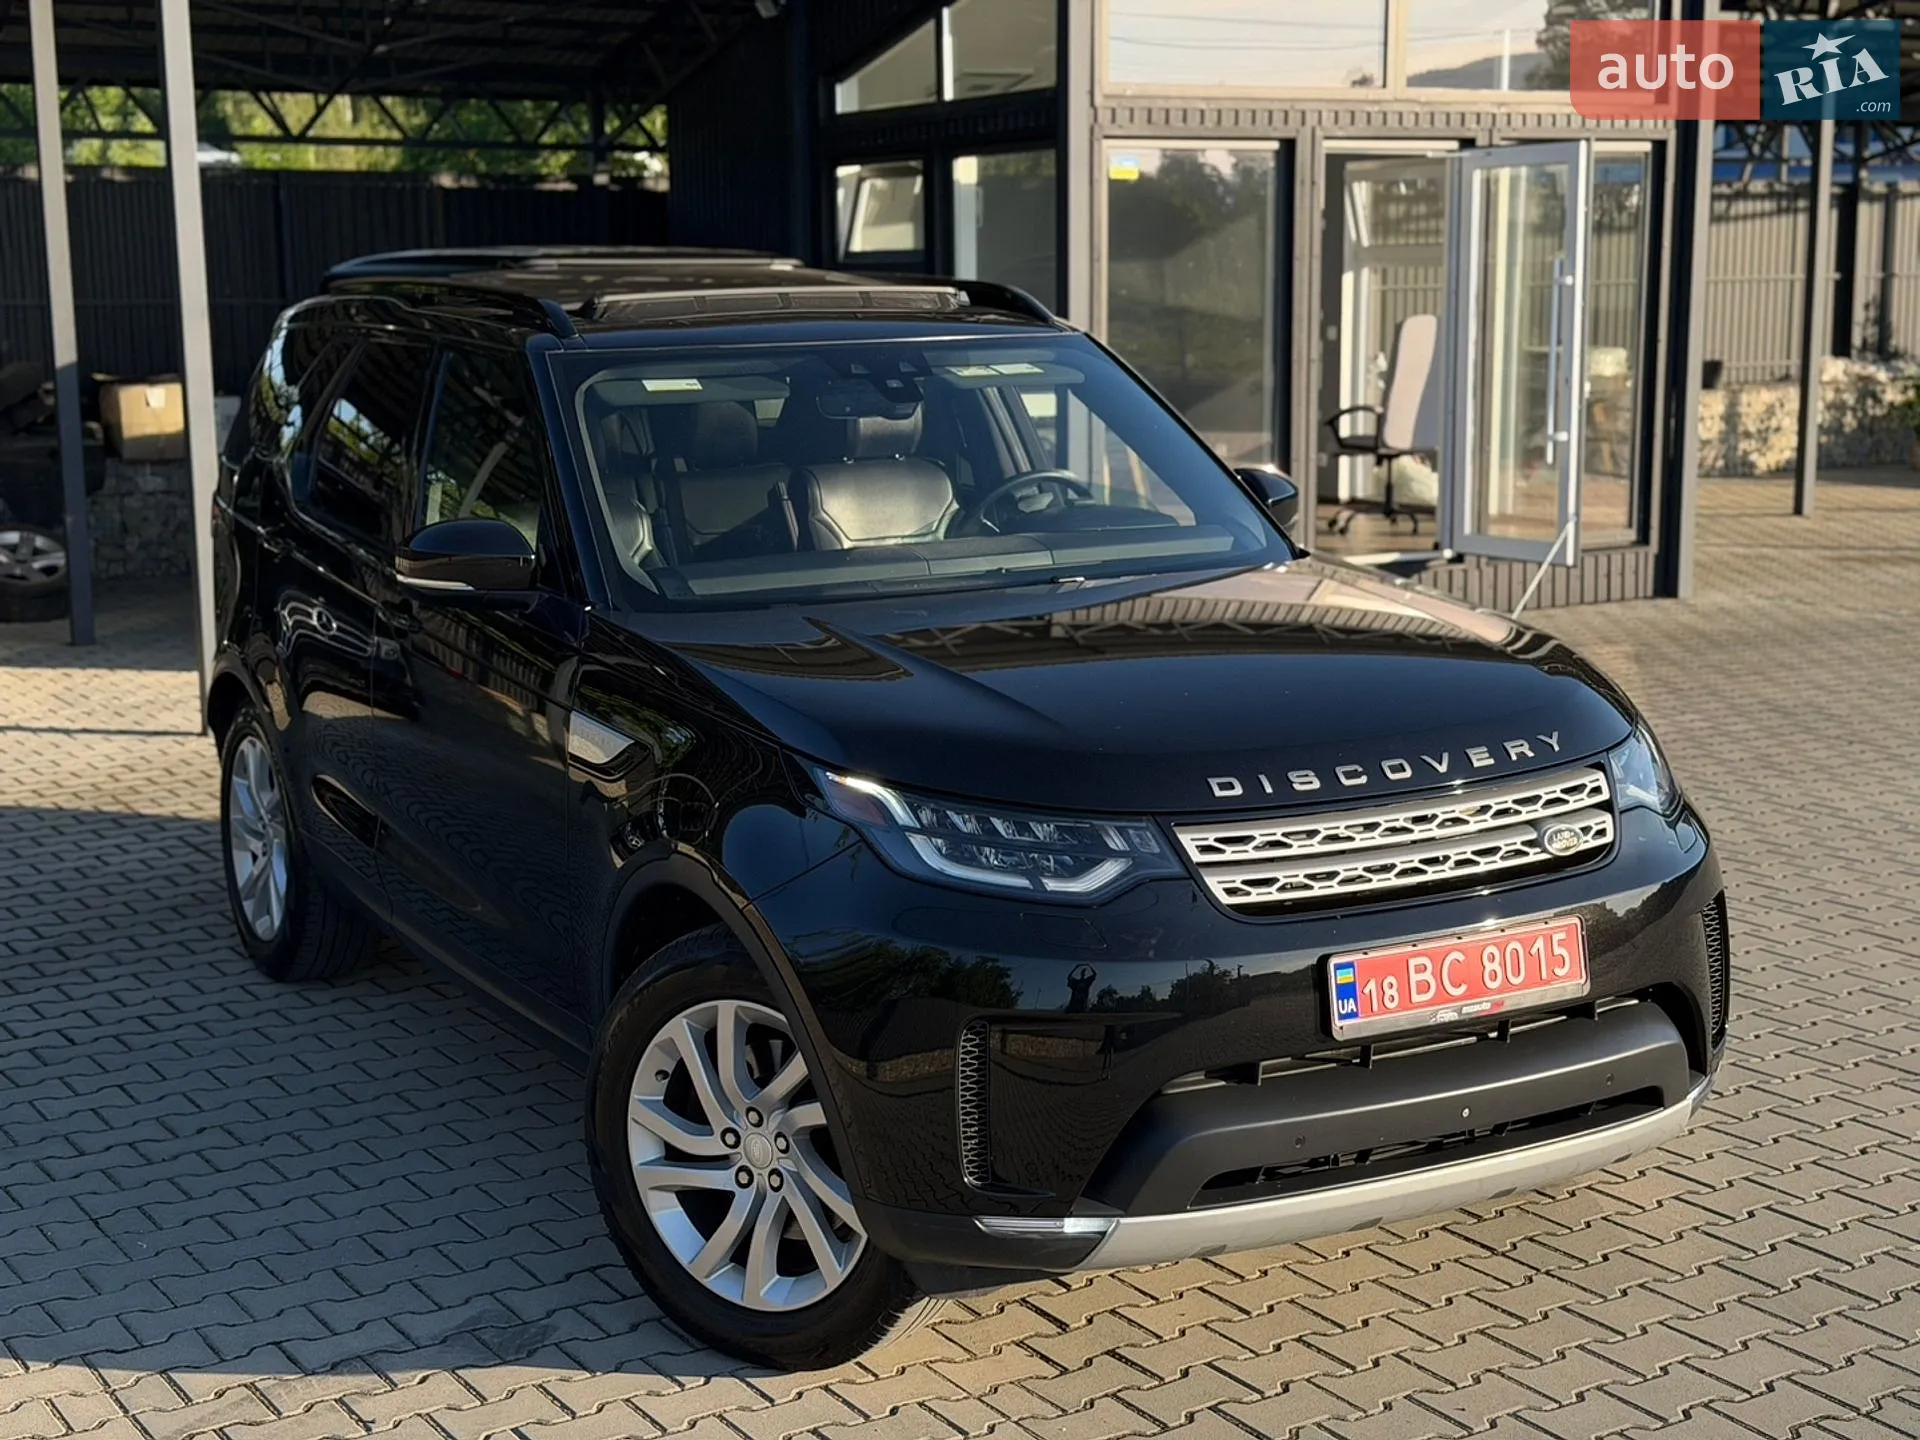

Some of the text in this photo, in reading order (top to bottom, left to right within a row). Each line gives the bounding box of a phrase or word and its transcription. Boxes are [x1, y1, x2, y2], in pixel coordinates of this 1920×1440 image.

[1207, 731, 1561, 798] DISCOVERY
[1362, 932, 1571, 1012] 18 BC 8015
[1338, 999, 1356, 1014] UA
